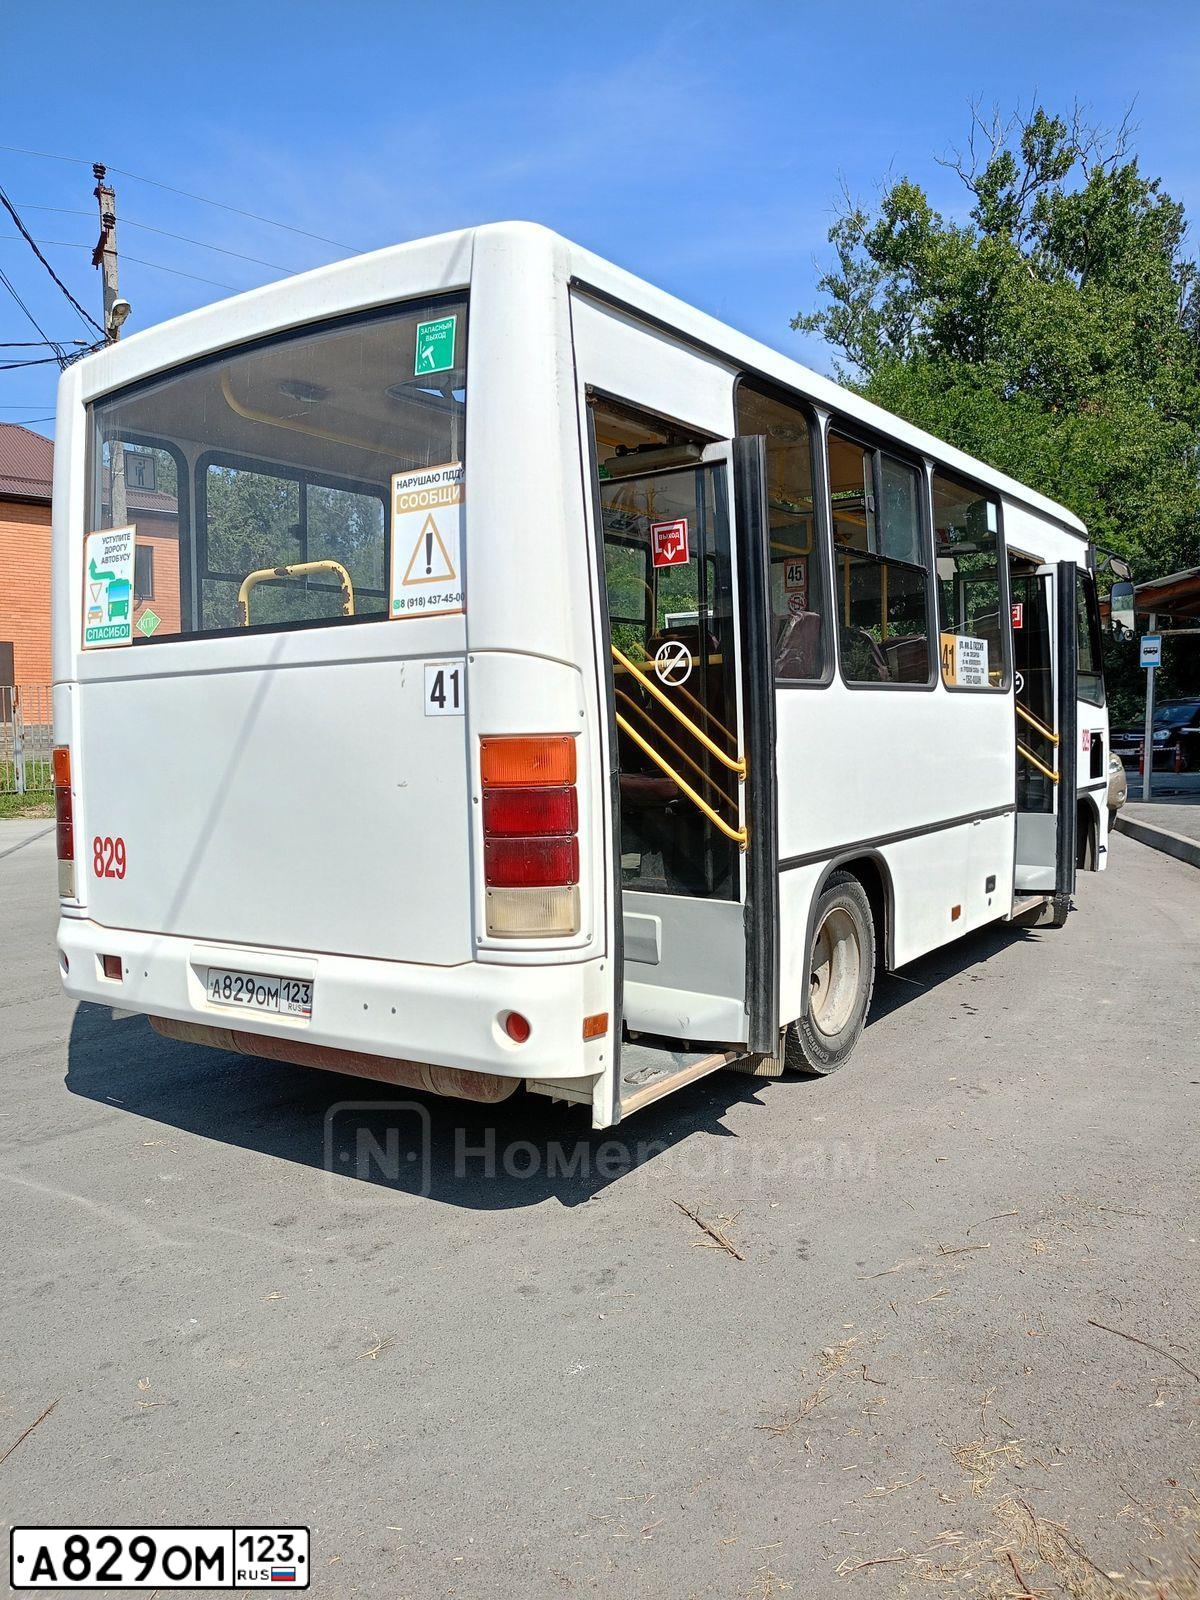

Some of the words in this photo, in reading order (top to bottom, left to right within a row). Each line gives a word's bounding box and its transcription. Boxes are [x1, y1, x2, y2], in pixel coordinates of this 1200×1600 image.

[420, 321, 452, 335] ЗАПАСНЫЙ
[425, 332, 447, 341] ВЫХОД
[396, 473, 441, 490] НАРУШАЮ
[400, 486, 461, 509] СООБЩИ
[101, 532, 131, 545] УСТУПИТЕ
[658, 530, 680, 540] ВЫХОД
[104, 543, 128, 555] ДОРОГУ
[101, 553, 131, 564] АВТОБУСУ
[787, 565, 803, 582] 45
[400, 598, 406, 608] 8
[406, 596, 426, 609] (918)
[140, 617, 155, 629] КПГ
[87, 624, 130, 640] СПАСИБО!
[942, 643, 954, 676] 41
[430, 669, 460, 709] 41
[93, 836, 127, 880] 829
[212, 975, 279, 1008] А829ОМ
[283, 982, 310, 1004] 123
[287, 1003, 302, 1012] RUS
